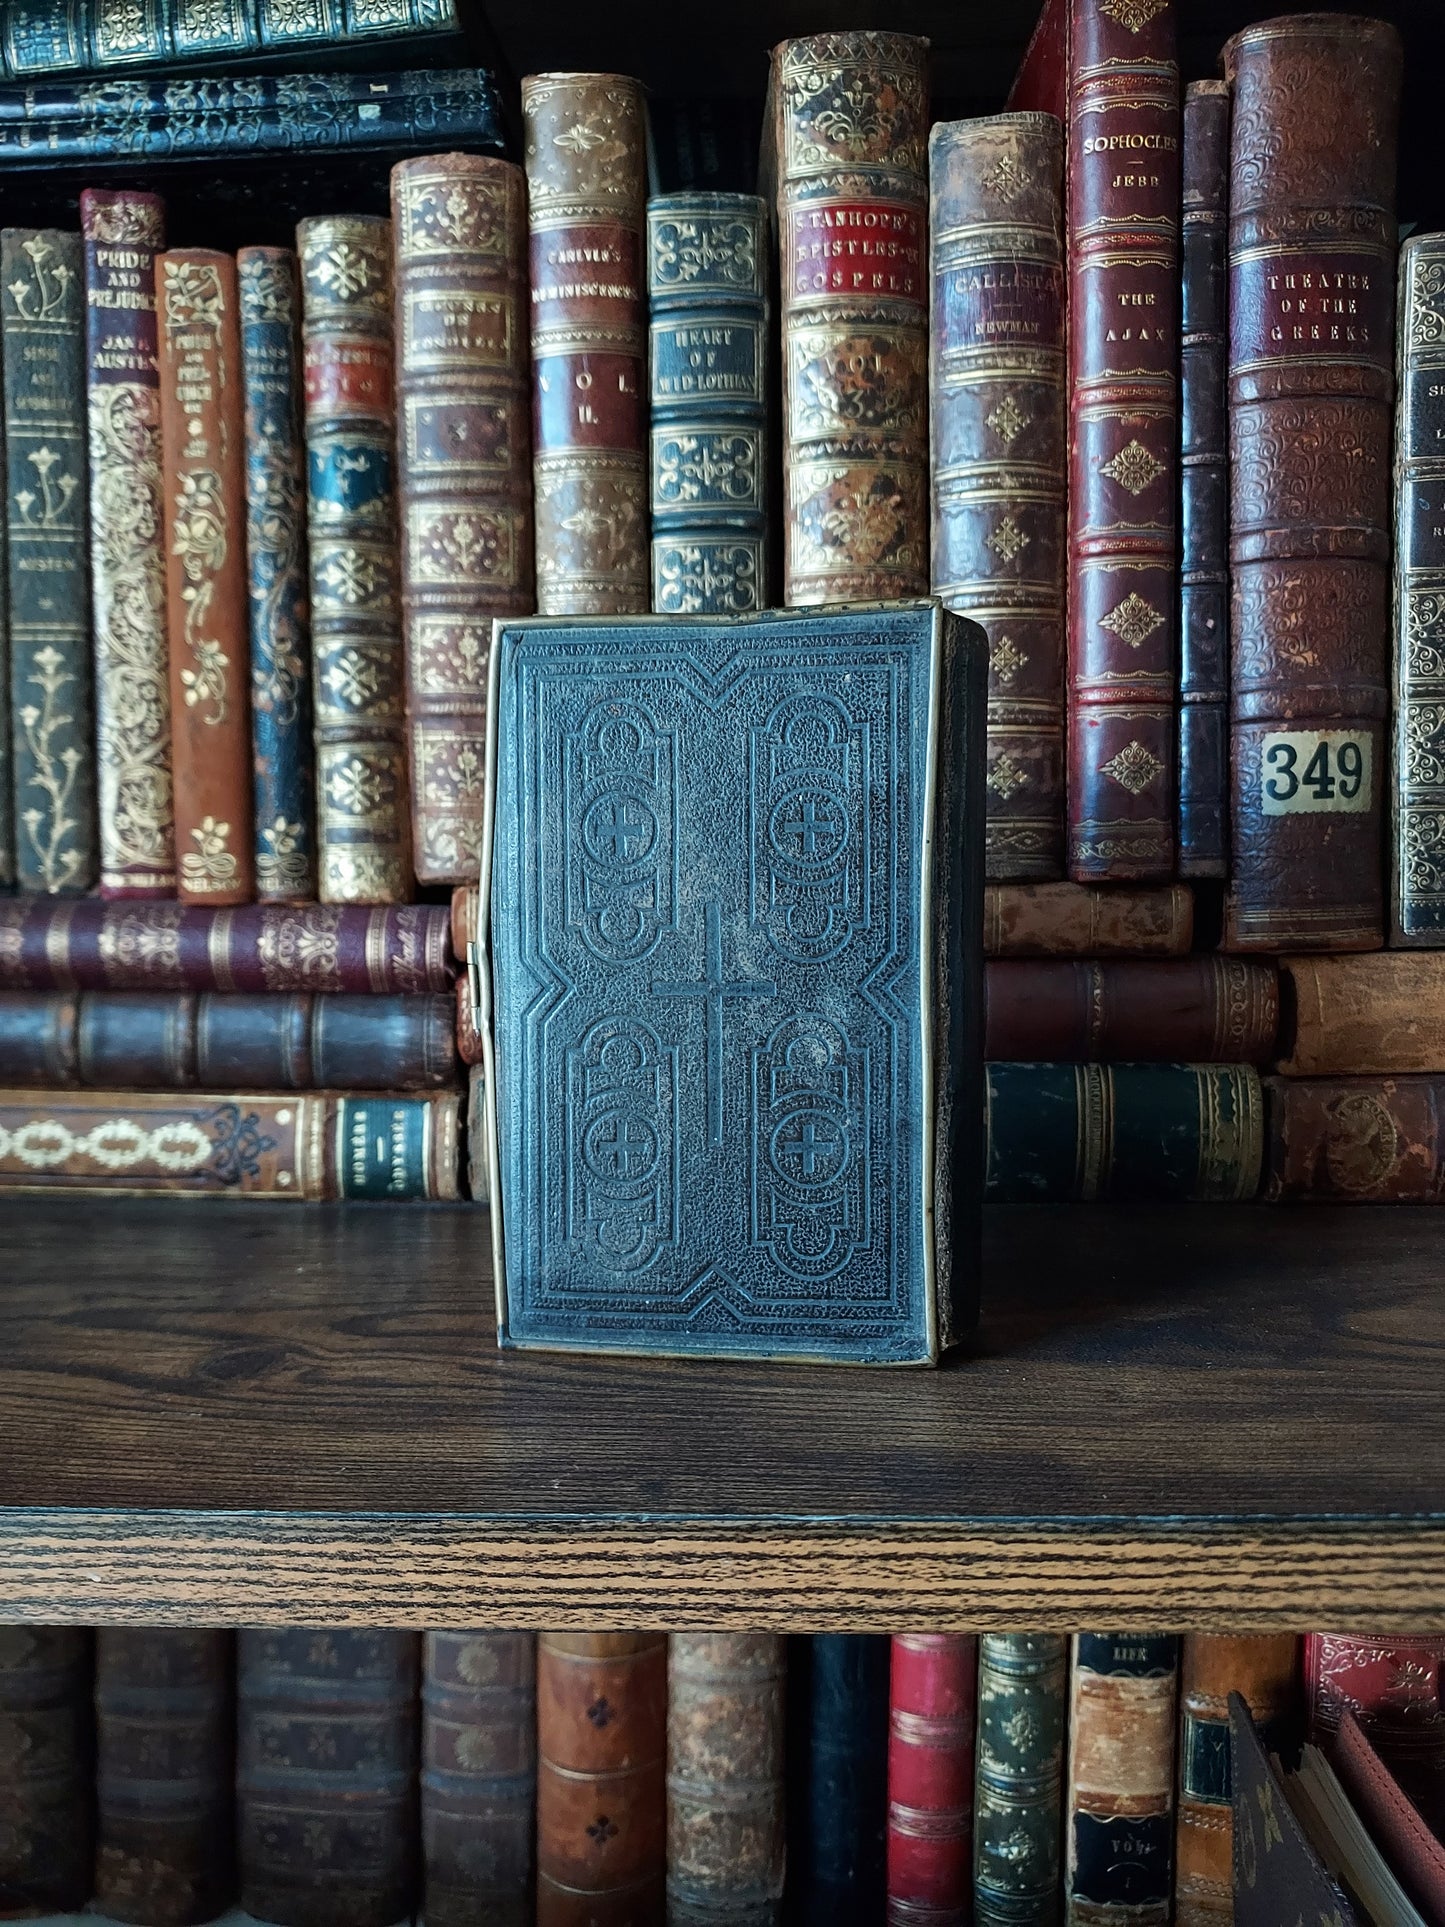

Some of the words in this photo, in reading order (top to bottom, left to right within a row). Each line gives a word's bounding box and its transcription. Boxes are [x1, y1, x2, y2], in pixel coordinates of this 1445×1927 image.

[1083, 134, 1177, 155] SOPHOCLES
[1112, 175, 1159, 188] JEBB
[96, 250, 151, 271] PRIDE
[107, 272, 141, 287] AND
[796, 271, 913, 293] GOSPELS
[955, 273, 1055, 294] CALLISTA
[1267, 273, 1370, 290] THEATRE
[1118, 293, 1155, 306] THE
[1281, 298, 1308, 313] OF
[1319, 298, 1357, 314] THE
[975, 320, 1040, 336] NEWMAN
[1106, 328, 1165, 342] AJAX
[1270, 325, 1370, 343] GREEKS
[675, 329, 732, 348] HEART
[689, 351, 716, 368] OF
[1265, 742, 1362, 800] 349
[181, 876, 241, 892] NELSON
[1112, 1646, 1148, 1662] LIFE
